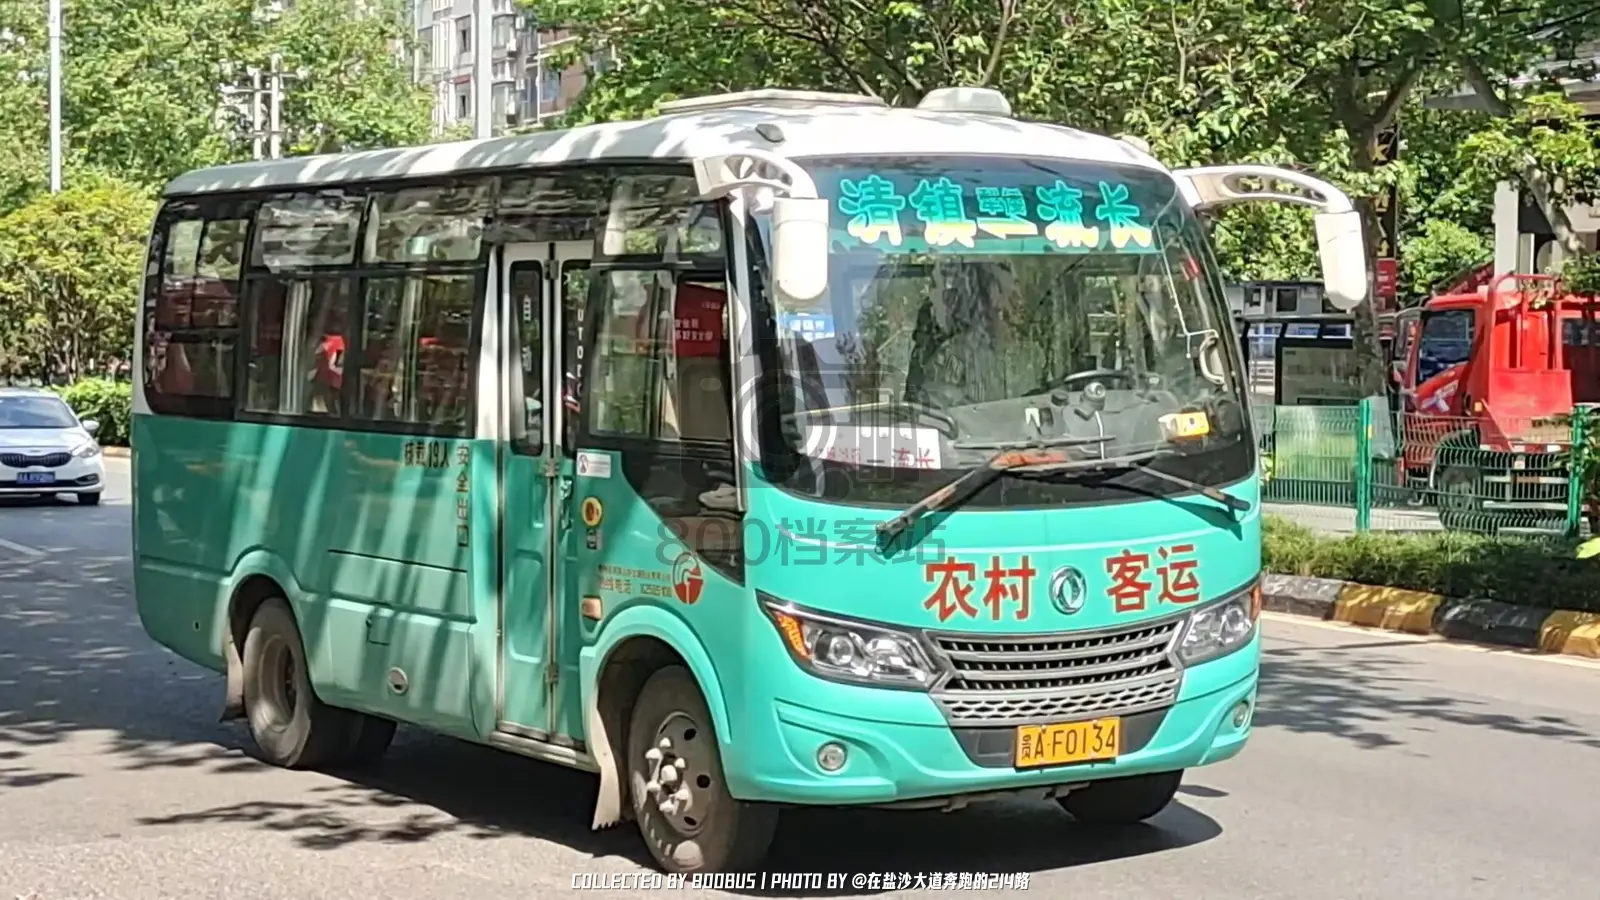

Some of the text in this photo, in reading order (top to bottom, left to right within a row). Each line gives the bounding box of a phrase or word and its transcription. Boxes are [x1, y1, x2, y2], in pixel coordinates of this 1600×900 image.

[839, 175, 976, 246] 清镇
[1036, 180, 1153, 247] 流长
[456, 443, 470, 548] 安全出口
[923, 544, 1200, 622] 农村 客运
